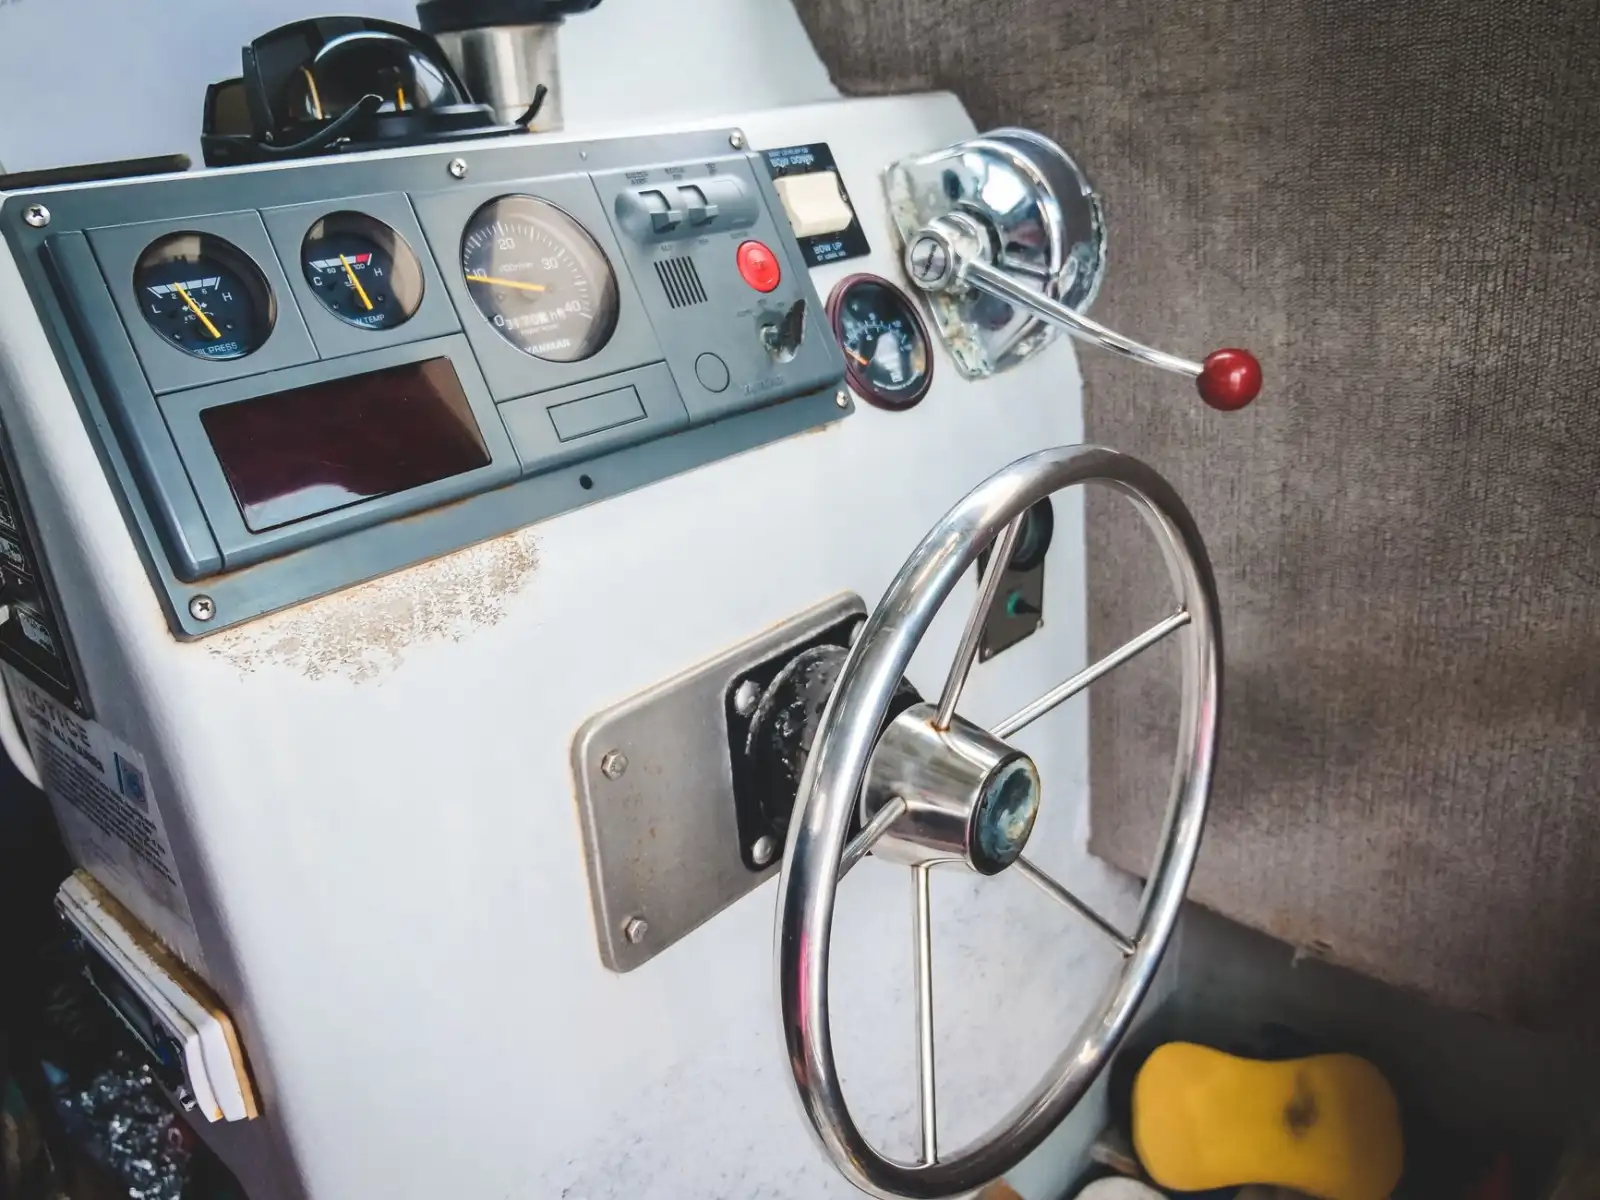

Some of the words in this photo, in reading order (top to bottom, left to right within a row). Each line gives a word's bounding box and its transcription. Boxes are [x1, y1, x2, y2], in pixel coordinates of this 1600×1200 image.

[497, 237, 515, 250] 20
[812, 244, 831, 255] BOW
[831, 241, 843, 251] UP
[541, 258, 559, 270] 30
[374, 267, 383, 276] H
[313, 276, 323, 286] C
[222, 292, 233, 301] H
[151, 304, 161, 314] L
[563, 300, 582, 312] 40
[364, 313, 385, 324] TEMP
[494, 314, 504, 327] 0
[207, 341, 238, 354] PRESS
[524, 338, 571, 354] YANMAR
